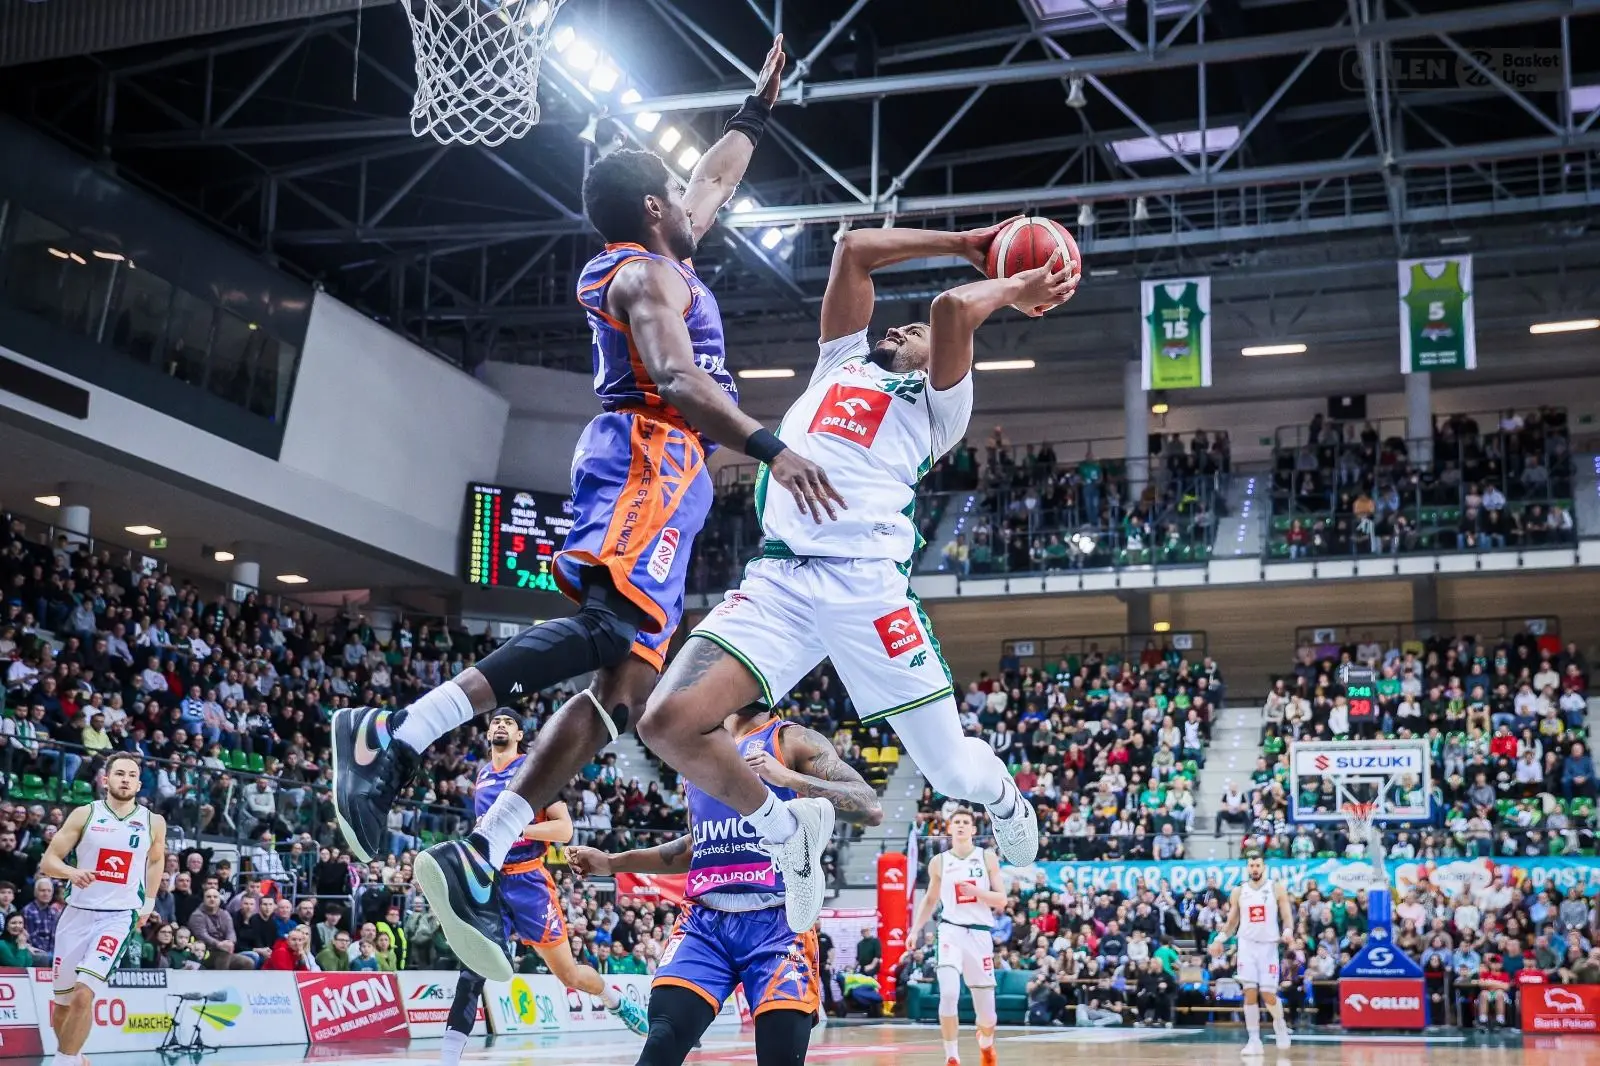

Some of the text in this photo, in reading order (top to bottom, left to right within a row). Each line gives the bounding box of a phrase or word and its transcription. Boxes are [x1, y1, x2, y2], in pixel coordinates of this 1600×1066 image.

[1428, 301, 1446, 320] 5
[1162, 321, 1189, 339] 15
[821, 416, 868, 436] ORLEN
[615, 511, 638, 557] GLIWICE
[512, 535, 525, 552] 5
[506, 557, 517, 570] 0
[517, 570, 559, 591] 7:41
[891, 632, 918, 651] ORLEN
[1350, 700, 1370, 715] 20
[1336, 756, 1411, 768] SUZUKI
[693, 817, 766, 846] GLIWIC
[129, 834, 140, 849] 0
[100, 870, 125, 879] ORLEN
[711, 870, 766, 883] TAURON
[968, 867, 983, 878] 13
[1060, 864, 1308, 895] SEKTOR RODZINY
[431, 988, 444, 999] PKS
[1370, 996, 1420, 1009] ORLEN
[1534, 1017, 1561, 1028] Bank
